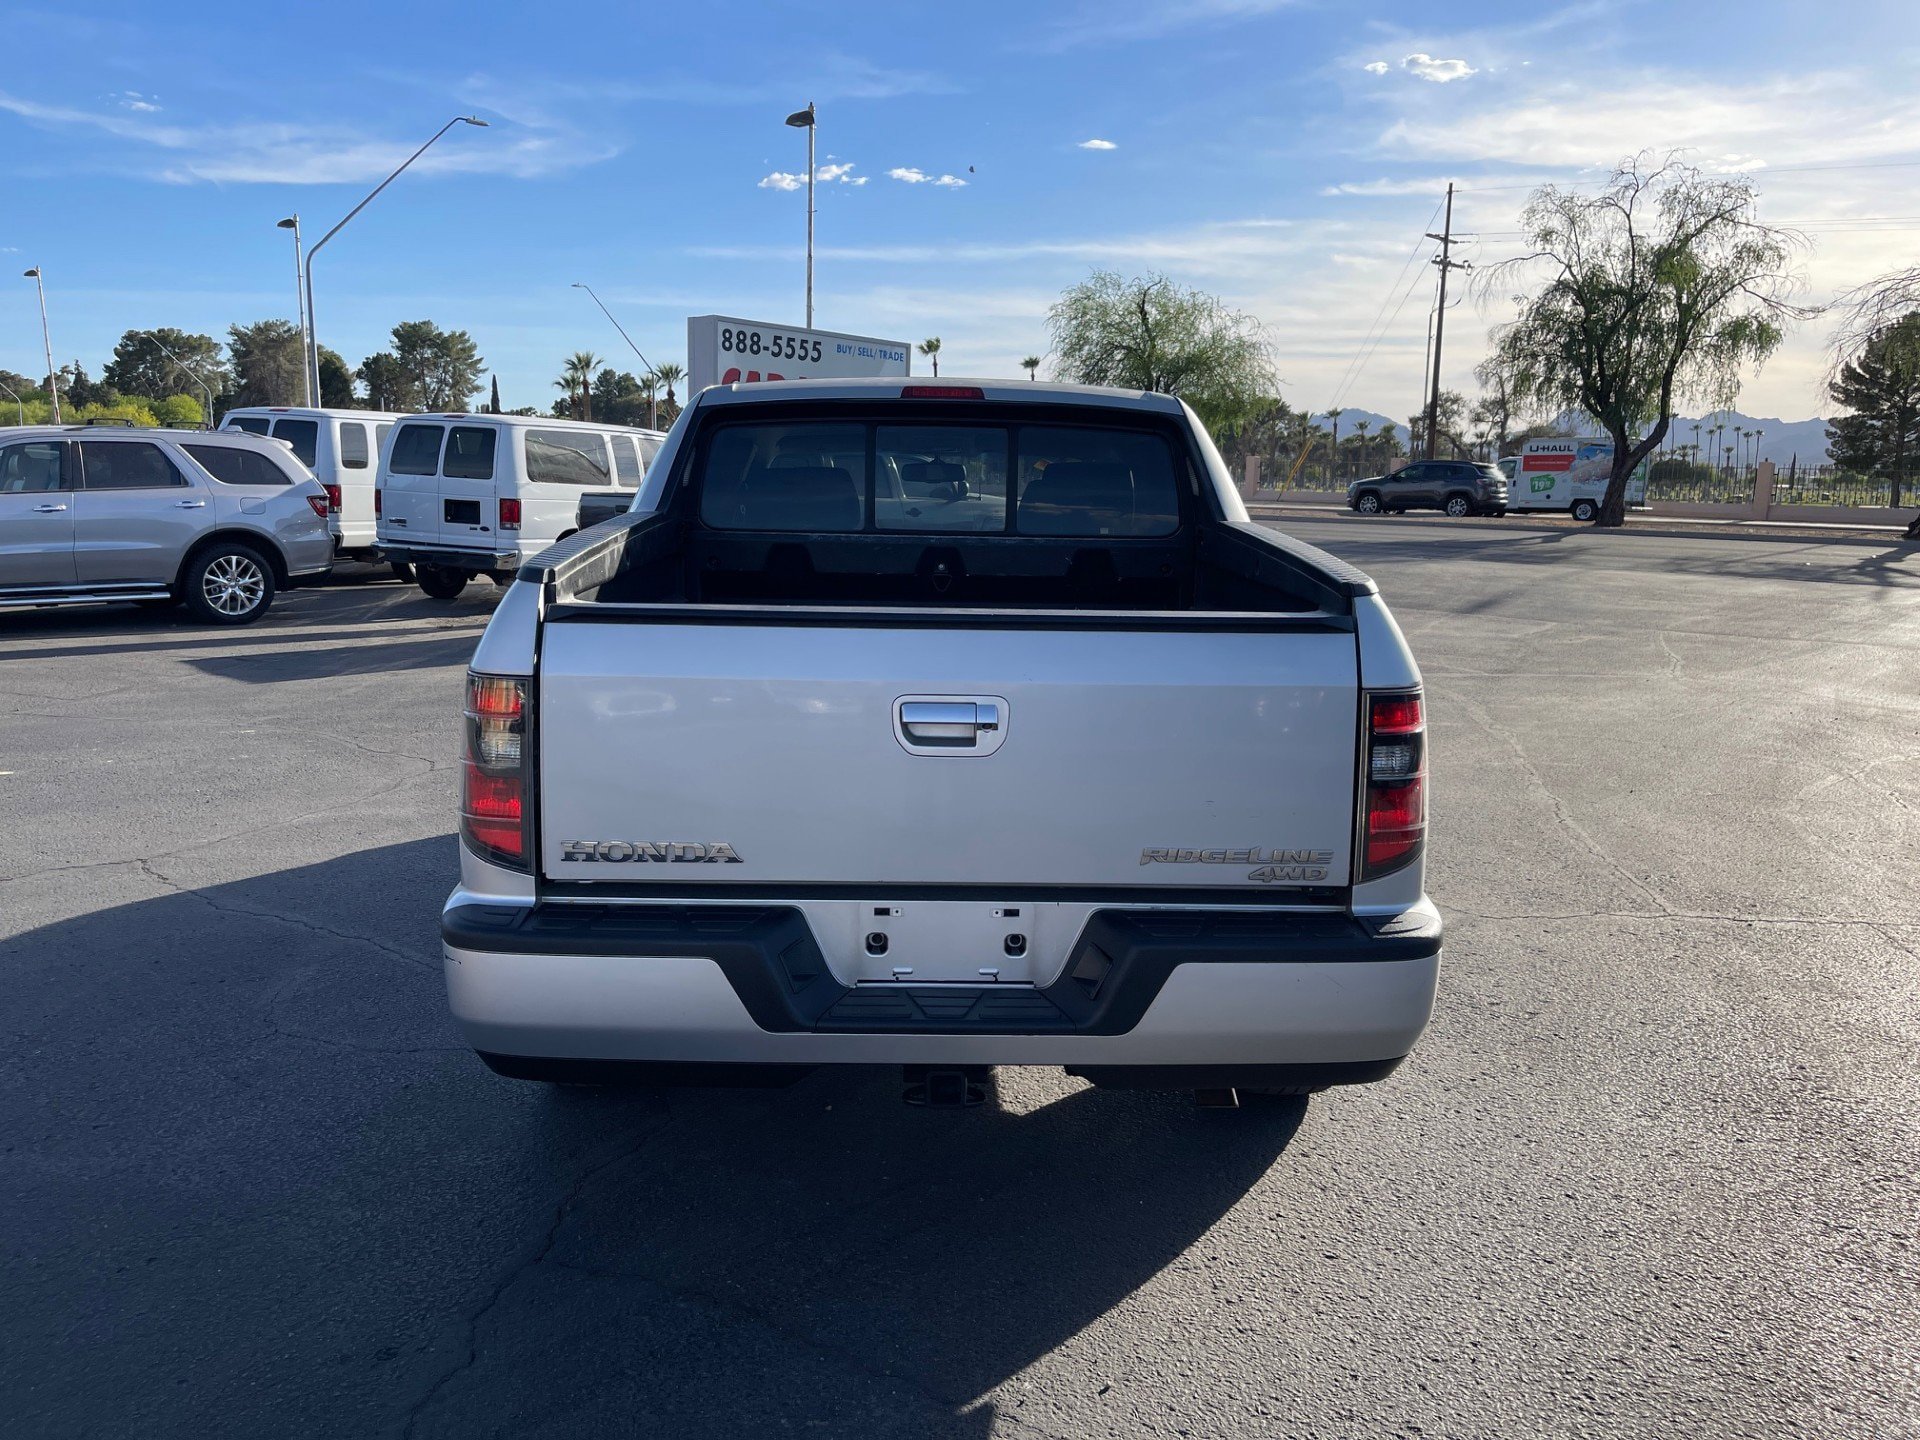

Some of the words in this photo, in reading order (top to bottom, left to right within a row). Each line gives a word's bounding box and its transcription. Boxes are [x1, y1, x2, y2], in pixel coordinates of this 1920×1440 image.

[722, 328, 822, 362] 888-5555
[879, 350, 904, 362] TRADE
[561, 840, 744, 863] HONDA
[1248, 866, 1329, 883] 4WD
